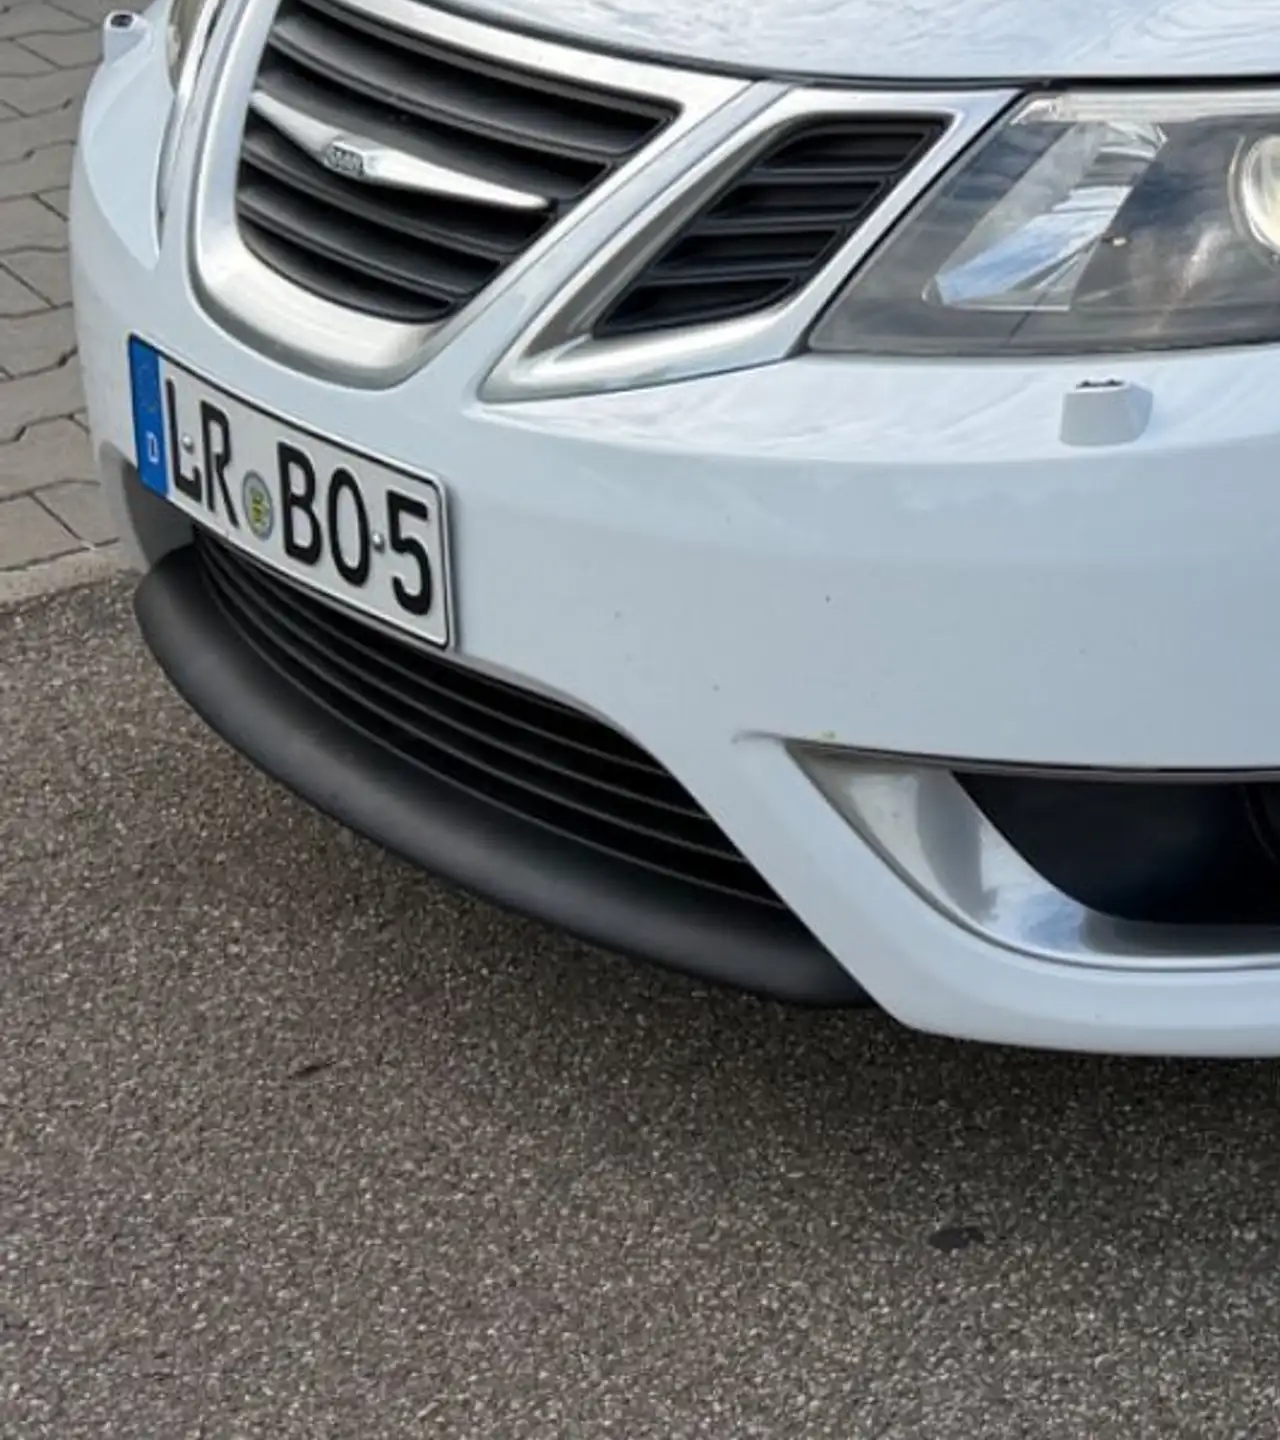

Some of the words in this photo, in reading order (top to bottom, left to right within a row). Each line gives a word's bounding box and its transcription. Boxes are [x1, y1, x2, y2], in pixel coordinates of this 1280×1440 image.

[165, 377, 240, 529] LR
[277, 440, 371, 588] BO
[386, 490, 434, 616] 5
